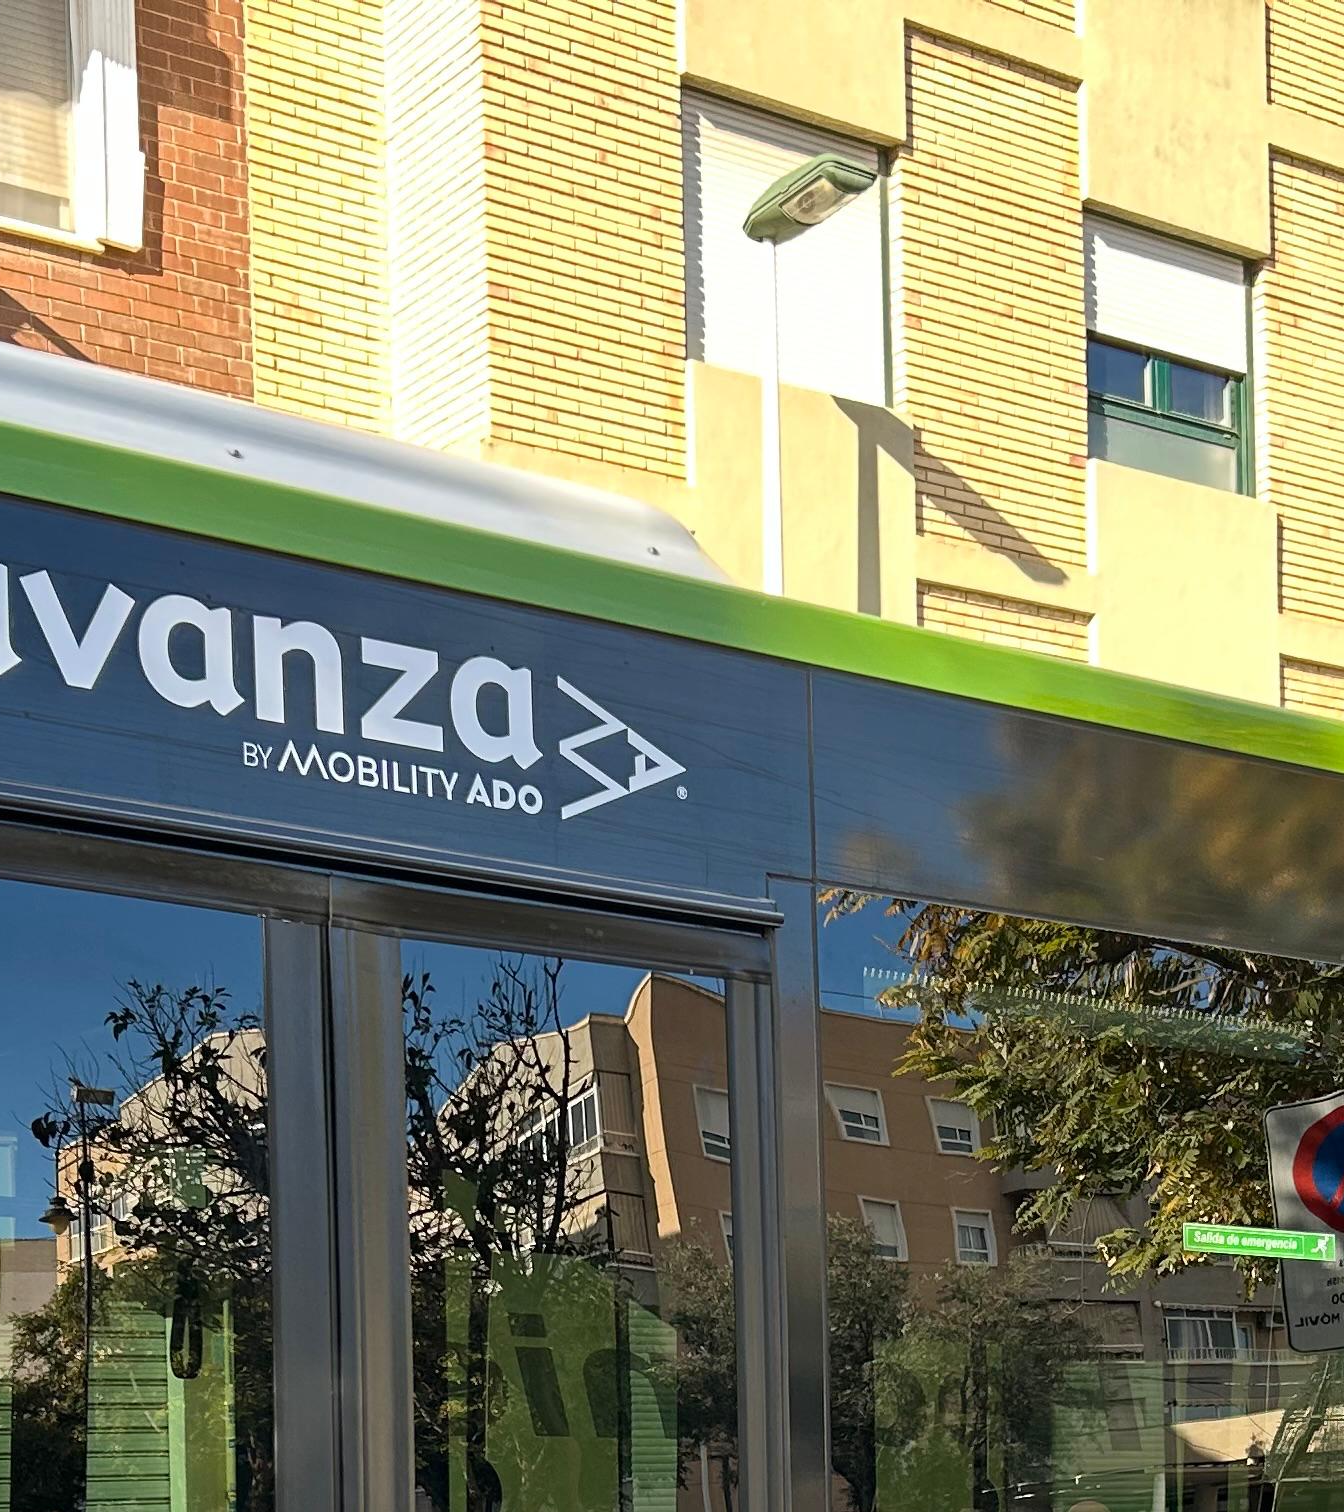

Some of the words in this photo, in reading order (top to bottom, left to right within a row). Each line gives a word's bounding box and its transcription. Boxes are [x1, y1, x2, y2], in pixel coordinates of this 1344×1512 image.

[242, 741, 273, 770] BY
[277, 739, 459, 801] MOBILITY
[466, 773, 544, 815] ADO
[1193, 1230, 1225, 1245] Salida
[1227, 1233, 1239, 1246] de
[1241, 1236, 1298, 1251] emergencia
